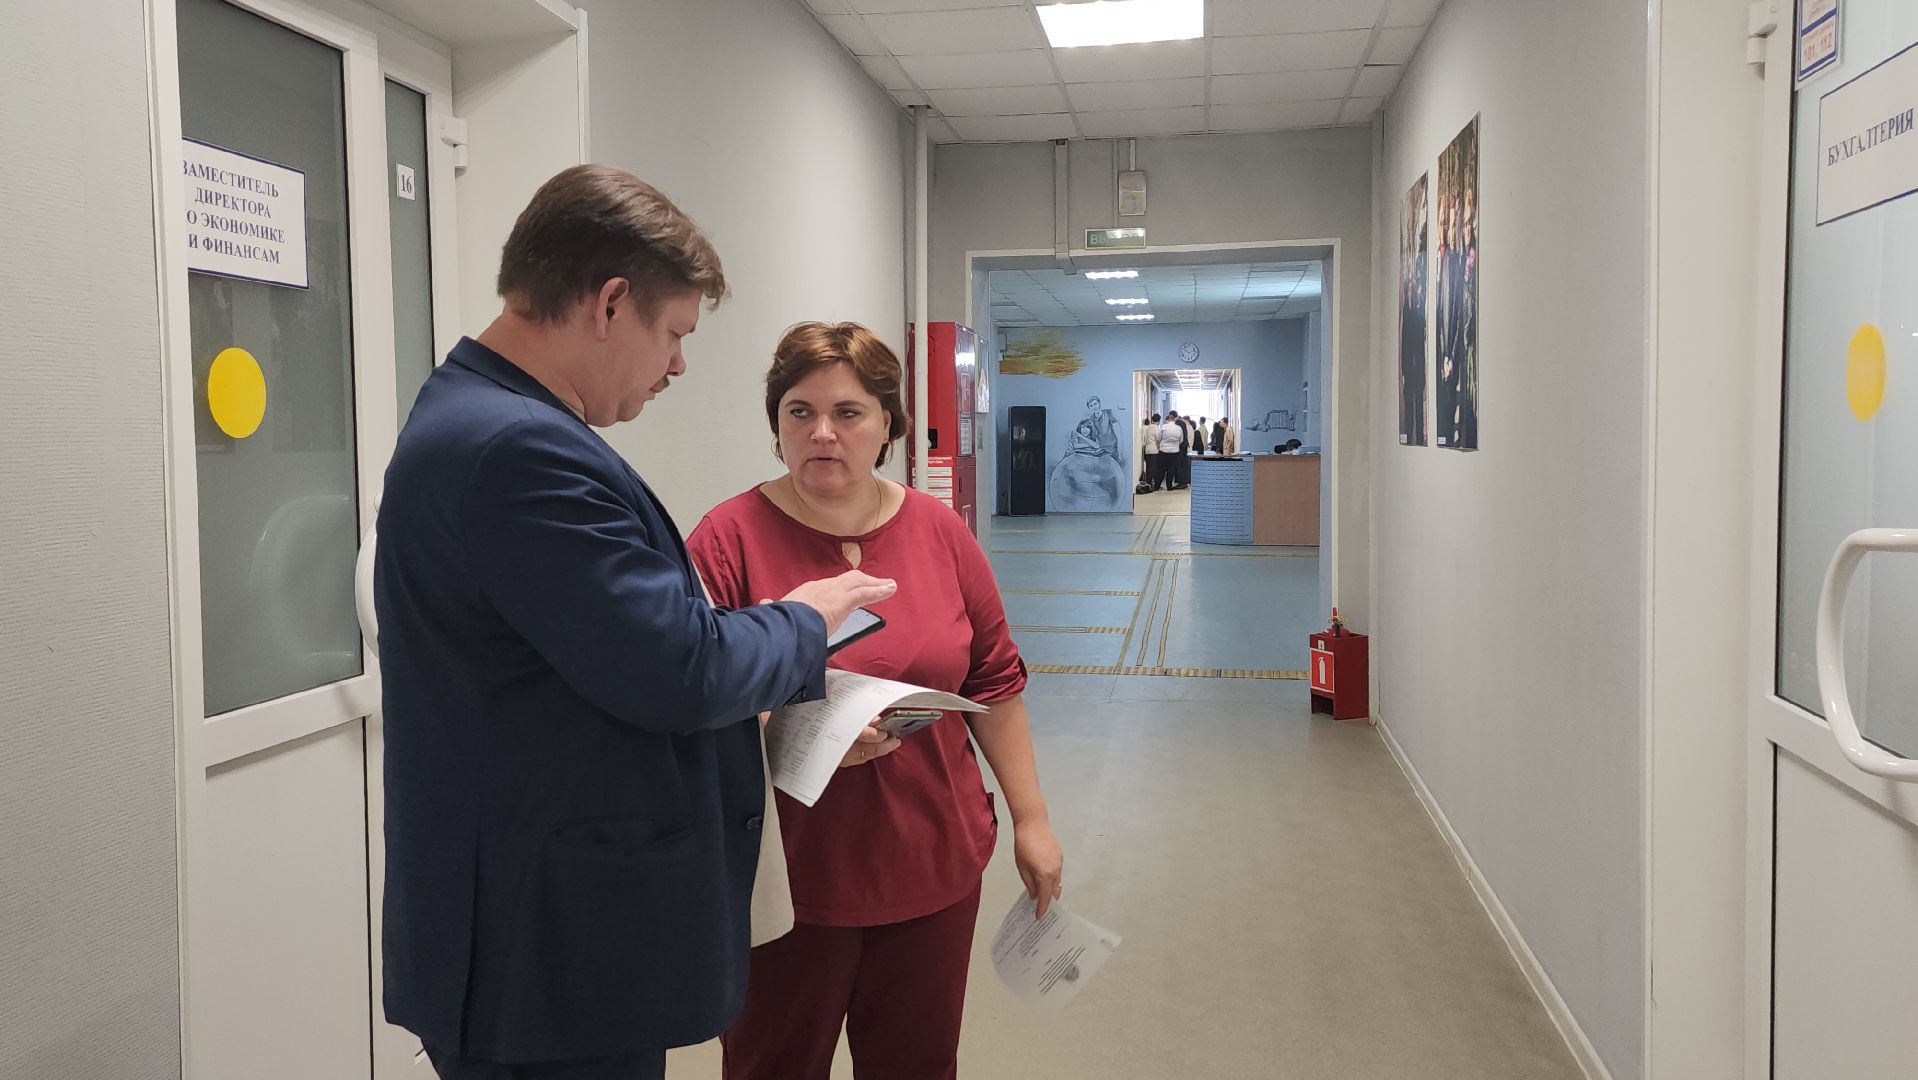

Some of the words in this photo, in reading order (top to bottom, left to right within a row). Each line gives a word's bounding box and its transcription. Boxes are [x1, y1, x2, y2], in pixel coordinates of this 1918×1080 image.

[1827, 107, 1914, 167] БУХГАЛТЕРИЯ
[401, 174, 412, 194] 16
[194, 187, 272, 219] ДИРЕКТОРА
[185, 208, 198, 225] О
[200, 212, 285, 244] ЭКОНОМИКЕ
[188, 233, 198, 249] И
[202, 236, 281, 264] ФИНАНСАМ
